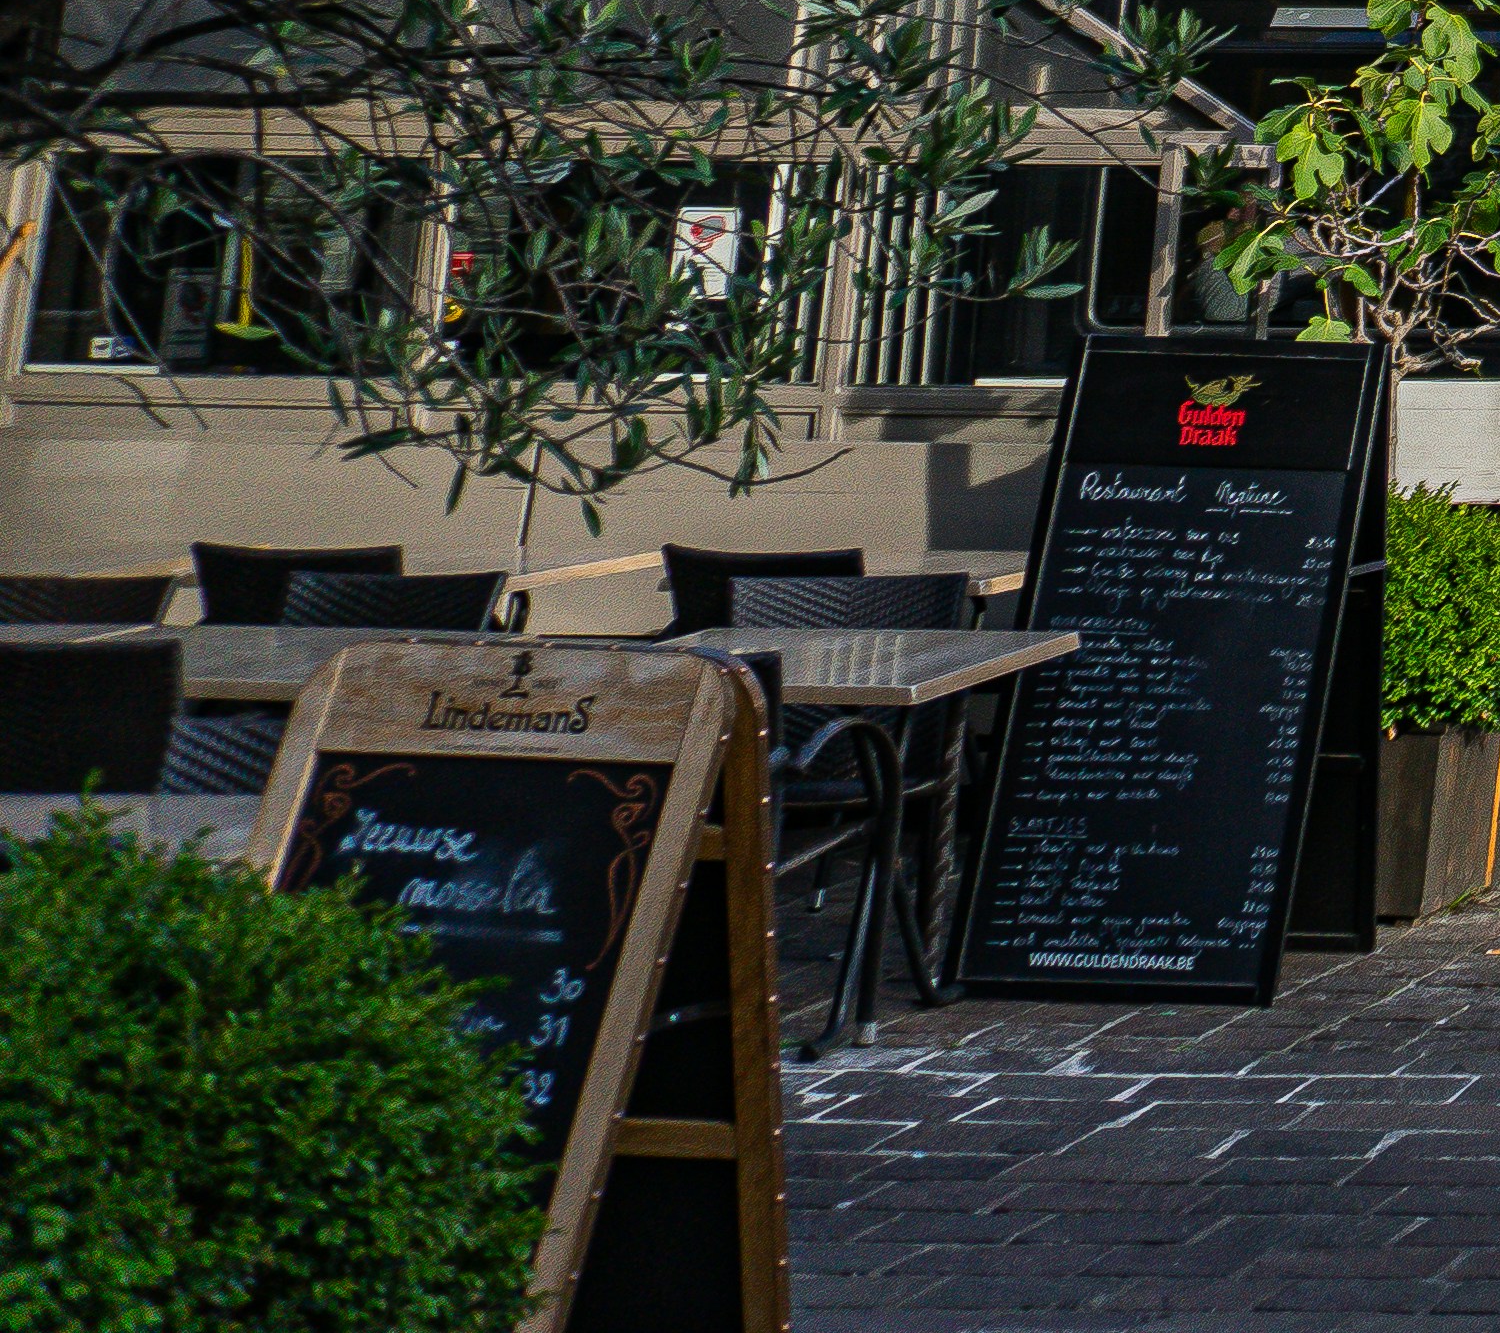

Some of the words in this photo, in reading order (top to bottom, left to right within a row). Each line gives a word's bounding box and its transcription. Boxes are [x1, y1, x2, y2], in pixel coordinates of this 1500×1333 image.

[1178, 400, 1247, 427] Gulden
[1179, 426, 1238, 446] Draak
[1079, 471, 1187, 503] Restaurant
[336, 808, 480, 864] Zeeuwse
[397, 845, 559, 915] mosselen
[1029, 952, 1197, 972] WWW.GULDENDRAAK.BE
[539, 966, 587, 1006] 30
[529, 1012, 572, 1047] 31
[521, 1069, 557, 1108] 32
